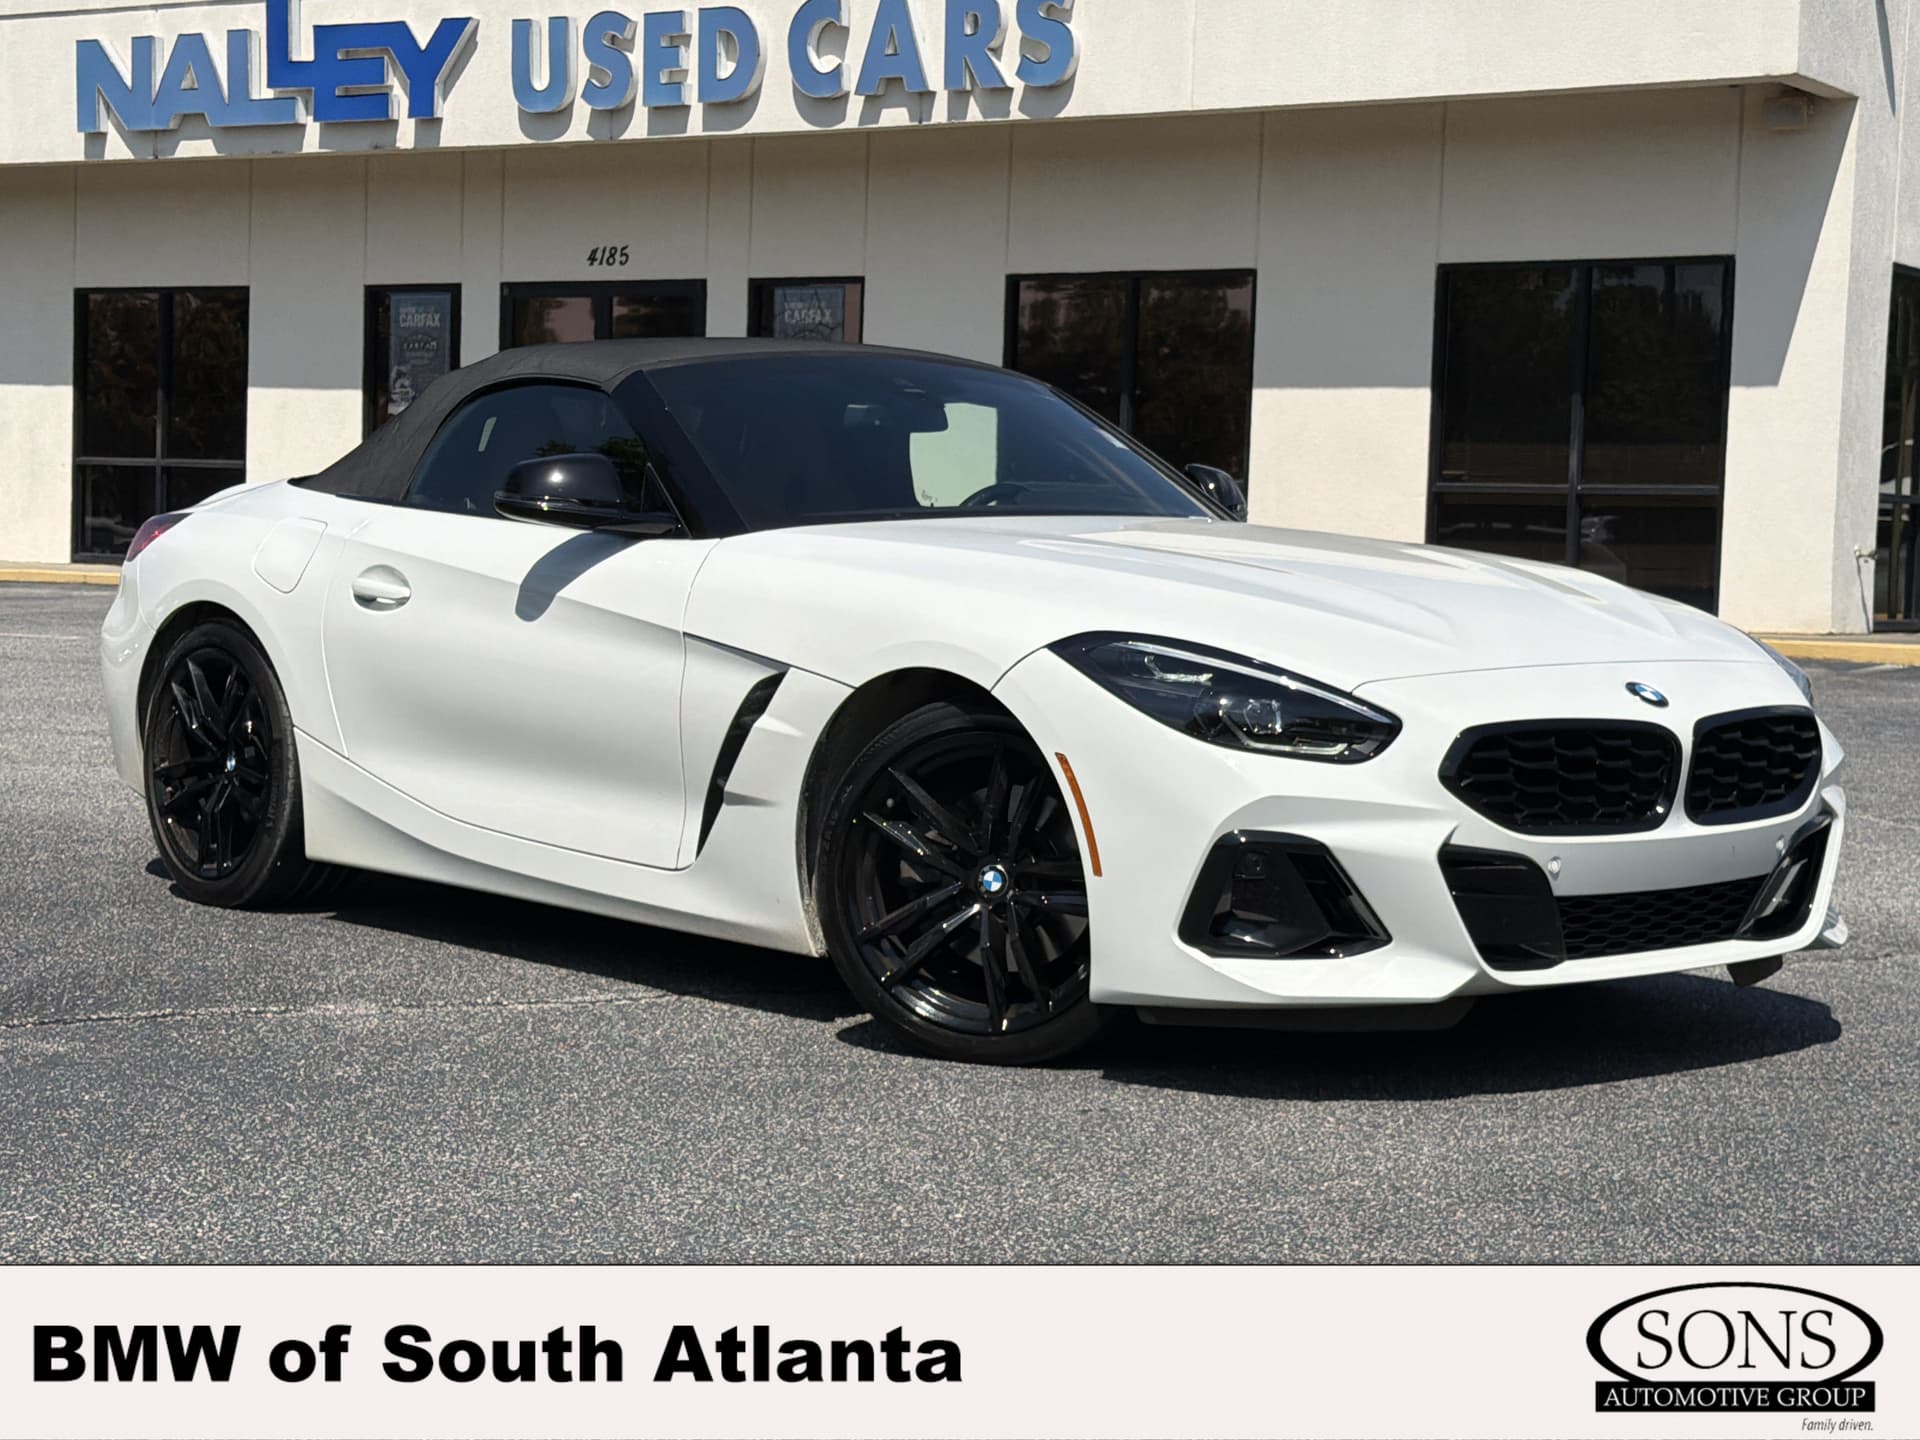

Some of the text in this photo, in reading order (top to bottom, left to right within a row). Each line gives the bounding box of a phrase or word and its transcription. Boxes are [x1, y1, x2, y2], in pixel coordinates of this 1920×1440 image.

[77, 0, 1077, 132] NALLEY USED CARS
[587, 245, 629, 266] 4185
[399, 312, 441, 328] CARFAX
